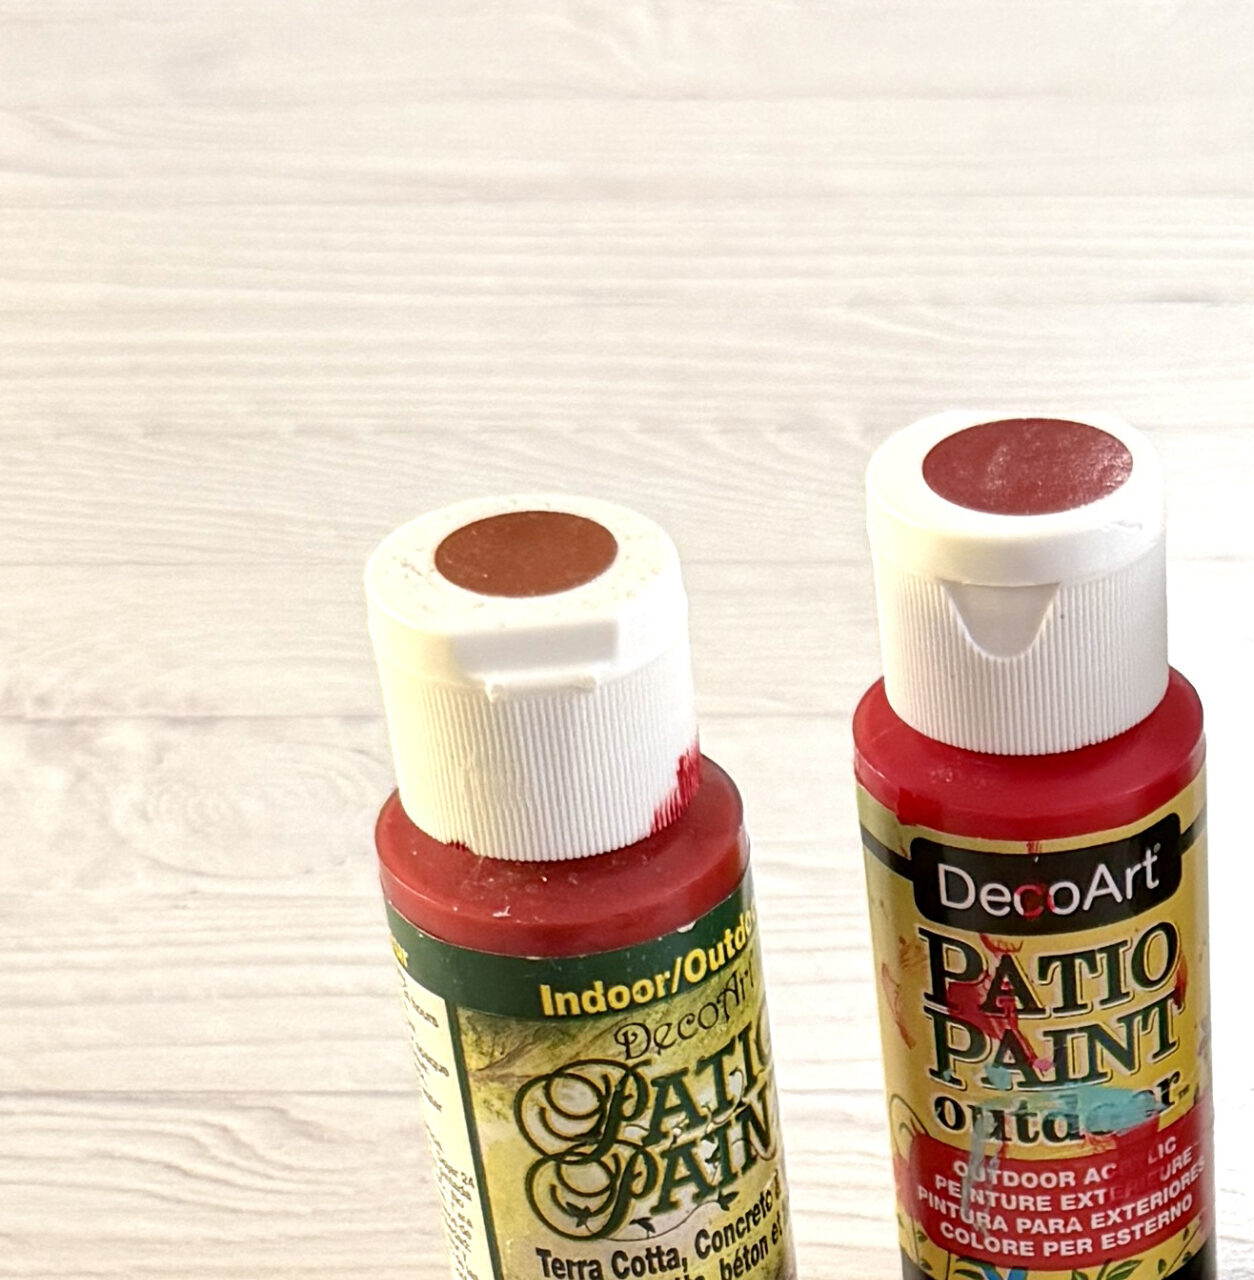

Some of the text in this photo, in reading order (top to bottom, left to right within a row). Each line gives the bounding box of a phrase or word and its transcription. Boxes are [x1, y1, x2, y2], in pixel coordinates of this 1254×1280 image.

[938, 849, 1160, 918] DecoArt
[918, 922, 1182, 1018] PATIO
[922, 986, 1187, 1091] PAINT
[934, 1070, 1182, 1143] outdr
[918, 1157, 1206, 1235] PINTURA PARA EXTERIORES
[935, 1145, 1193, 1212] PENTURE EXTURE
[953, 1135, 1178, 1189] OUTDOOR ACLIC
[940, 1193, 1193, 1258] COLORE PER ESTERNO
[536, 1247, 603, 1280] Terra
[611, 1245, 688, 1280] Cotta,
